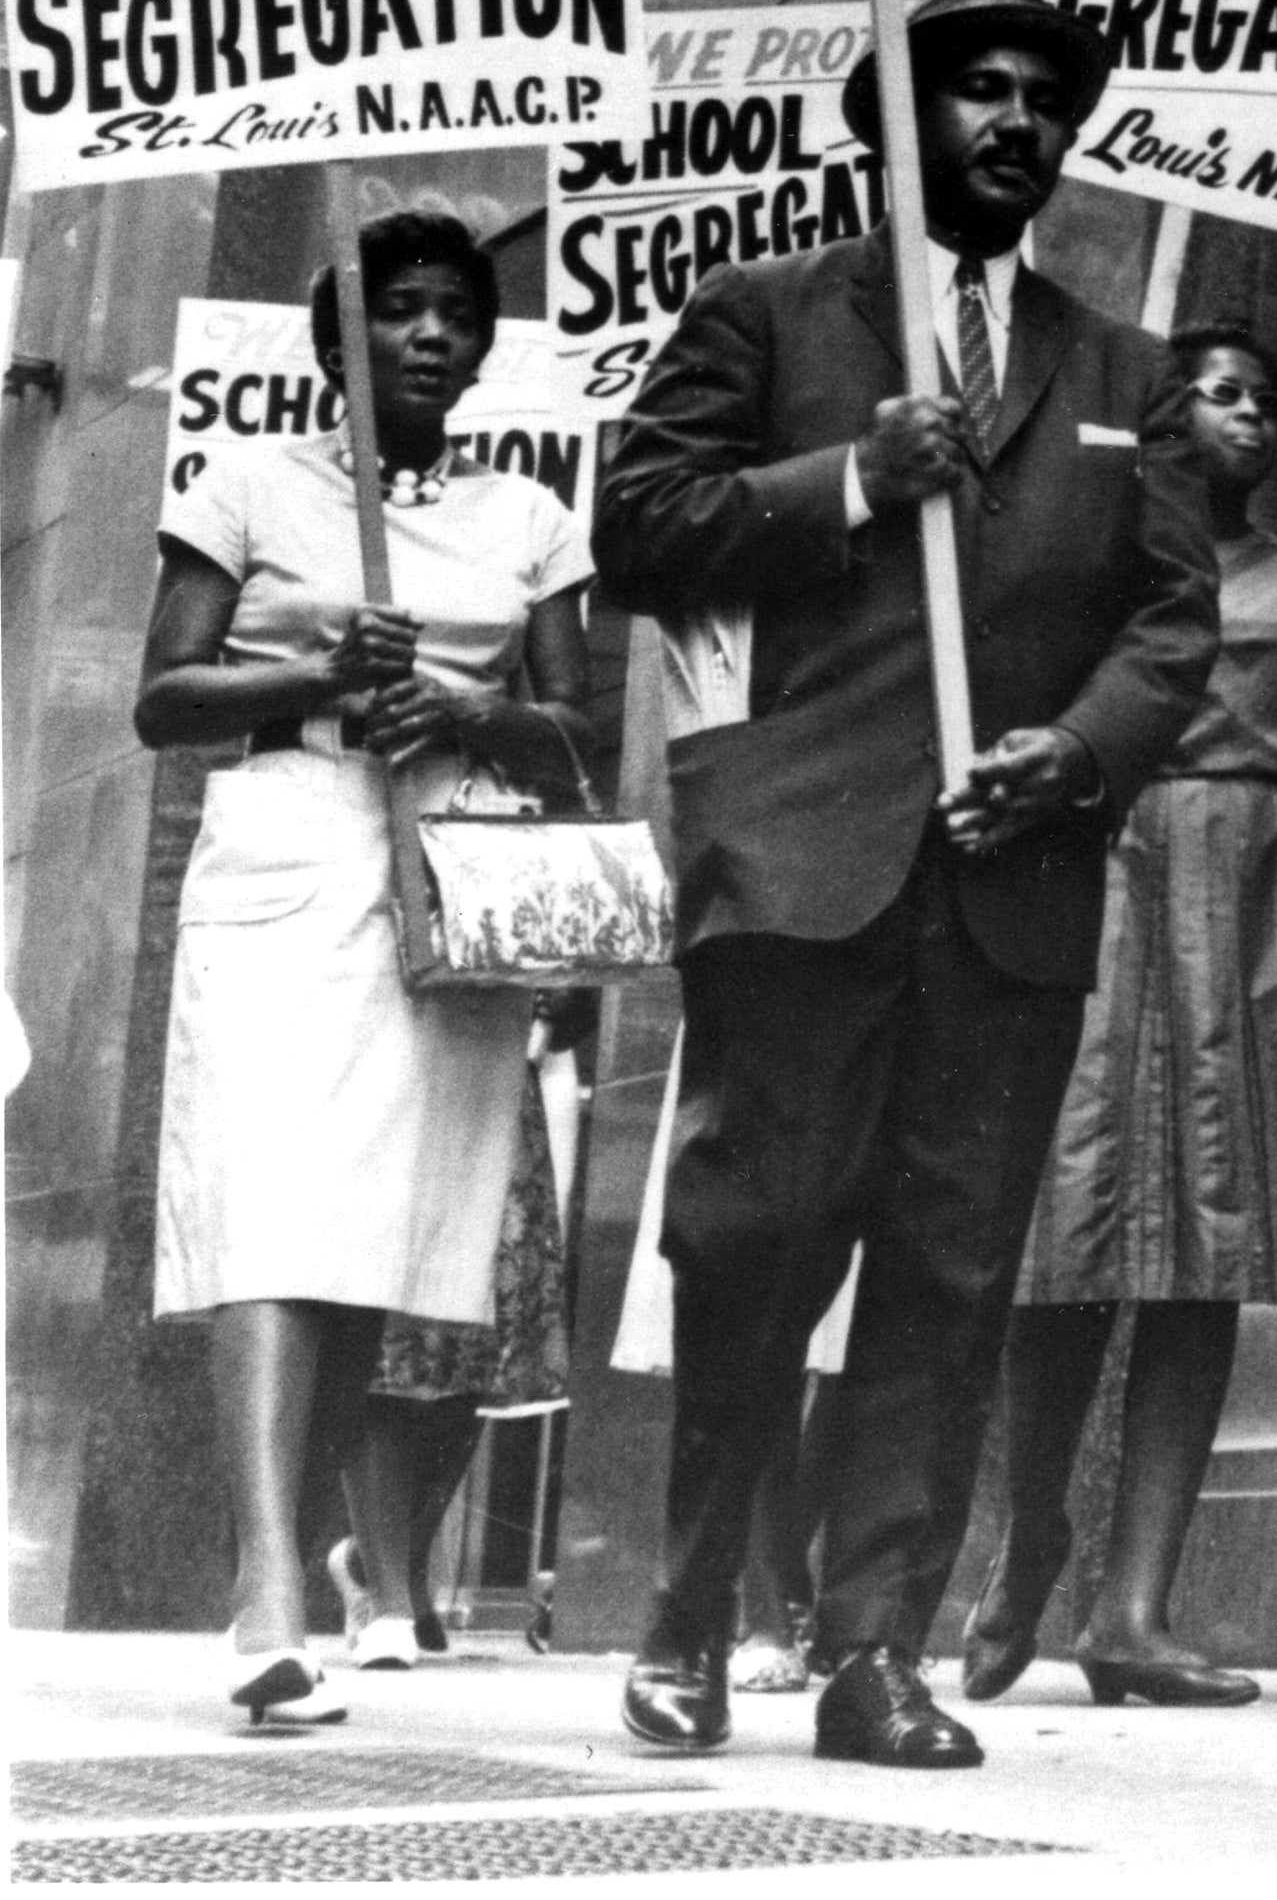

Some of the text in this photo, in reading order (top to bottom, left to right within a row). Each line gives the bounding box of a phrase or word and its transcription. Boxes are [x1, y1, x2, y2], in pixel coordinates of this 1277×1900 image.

[77, 75, 603, 160] St. Louis N.A.A.C.P.
[1082, 107, 1229, 189] Louis
